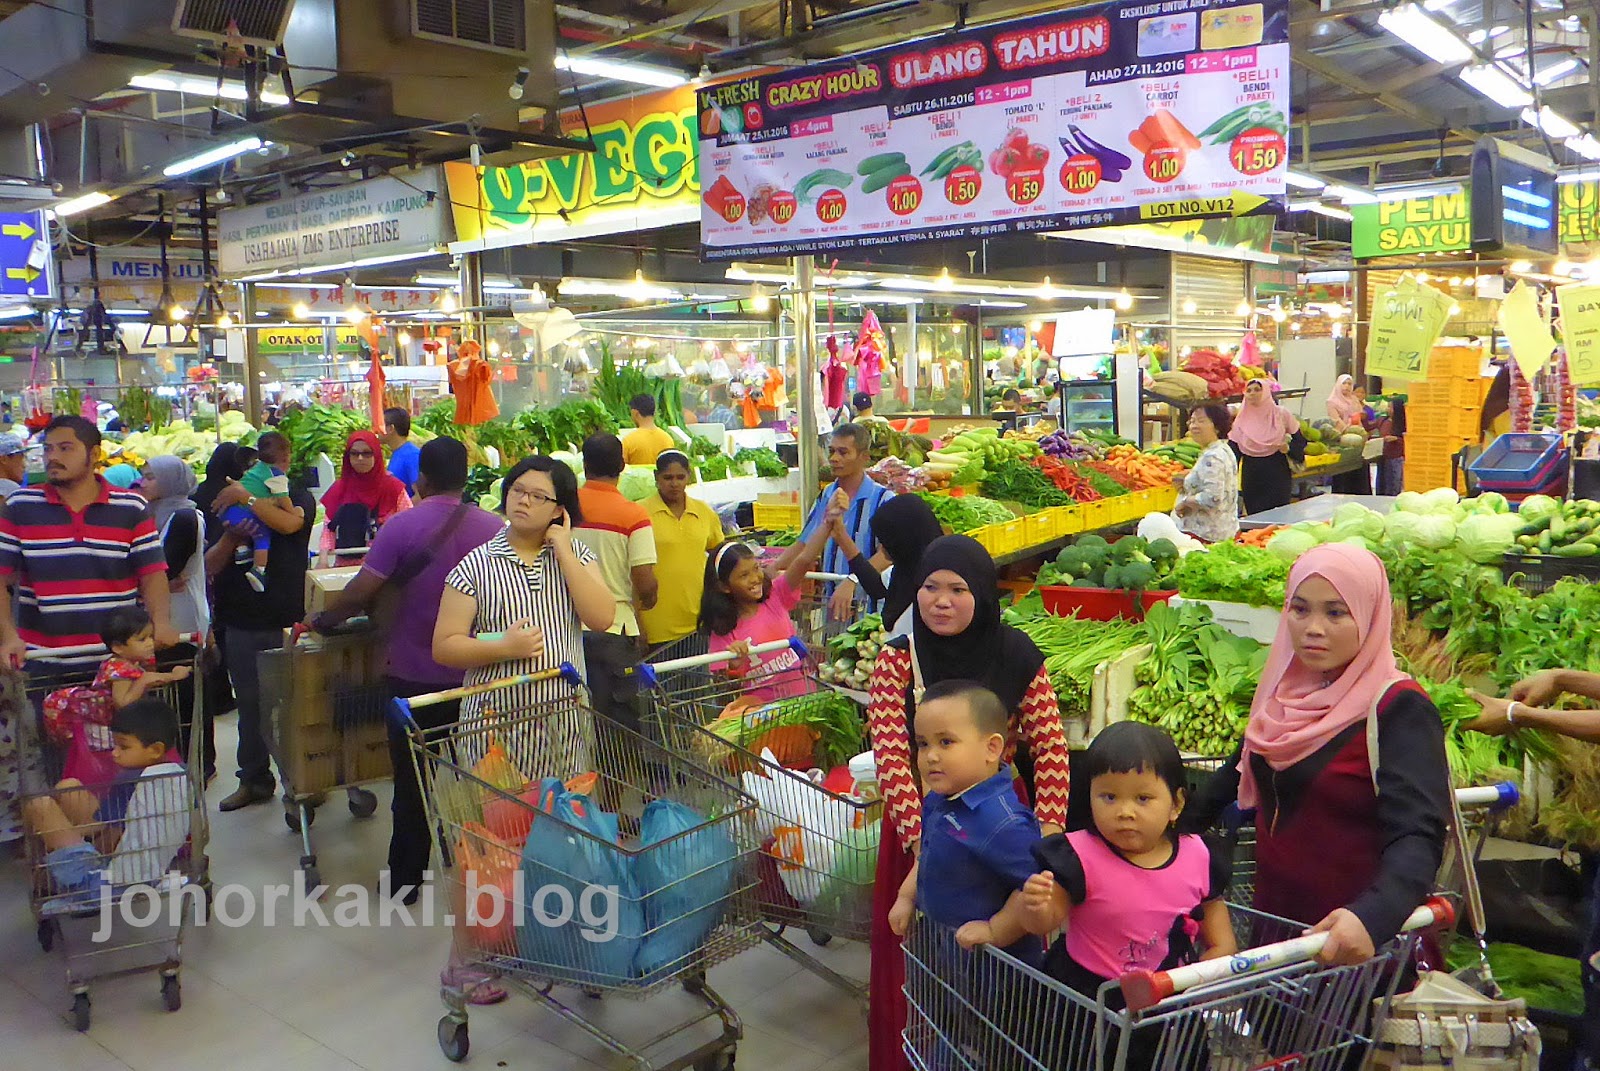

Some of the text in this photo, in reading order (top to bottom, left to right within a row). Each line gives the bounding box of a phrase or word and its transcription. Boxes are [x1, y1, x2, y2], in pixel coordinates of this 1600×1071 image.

[1120, 4, 1160, 18] EKSKLUSIF
[1162, 0, 1188, 12] UNTUK
[895, 19, 1104, 84] ULANG TAHUN
[1089, 68, 1121, 82] AHAD
[1124, 60, 1185, 76] 27.11.2016
[1190, 58, 1208, 69] 12
[1222, 54, 1254, 68] 1pm
[769, 68, 878, 106] CRAZY HOUR
[1146, 91, 1178, 101] CARROT
[1243, 82, 1270, 92] BENDI
[893, 103, 922, 116] SABTU
[924, 92, 974, 110] 26.11.2016
[978, 89, 992, 100] 12
[1003, 84, 1029, 98] 1pm
[1084, 102, 1112, 112] PANJANG
[1004, 104, 1034, 116] TOMATO
[752, 126, 788, 141] 25.11.2016
[794, 124, 799, 134] 3
[807, 120, 829, 133] 4pm
[1150, 158, 1179, 178] 1.00
[1234, 148, 1277, 171] 1.50
[1066, 170, 1096, 190] 1.00
[947, 182, 976, 201] 1.50
[1009, 181, 1039, 201] 1.59
[378, 195, 428, 214] KAMPUNG
[892, 191, 918, 211] 1.00
[1150, 198, 1234, 216] LOT NO. V12
[724, 204, 742, 219] 1.00
[772, 204, 793, 220] 1.00
[821, 204, 842, 218] 1.00
[303, 233, 324, 254] ZMS
[328, 220, 400, 250] ENTERPRISE
[818, 242, 836, 250] STOK
[837, 238, 854, 248] LAST
[858, 236, 899, 246] TERTAKLUK
[900, 232, 926, 242] TERMA
[935, 228, 964, 239] SYARAT
[343, 335, 358, 344] JB
[1377, 336, 1390, 344] RM
[1576, 340, 1592, 348] RM
